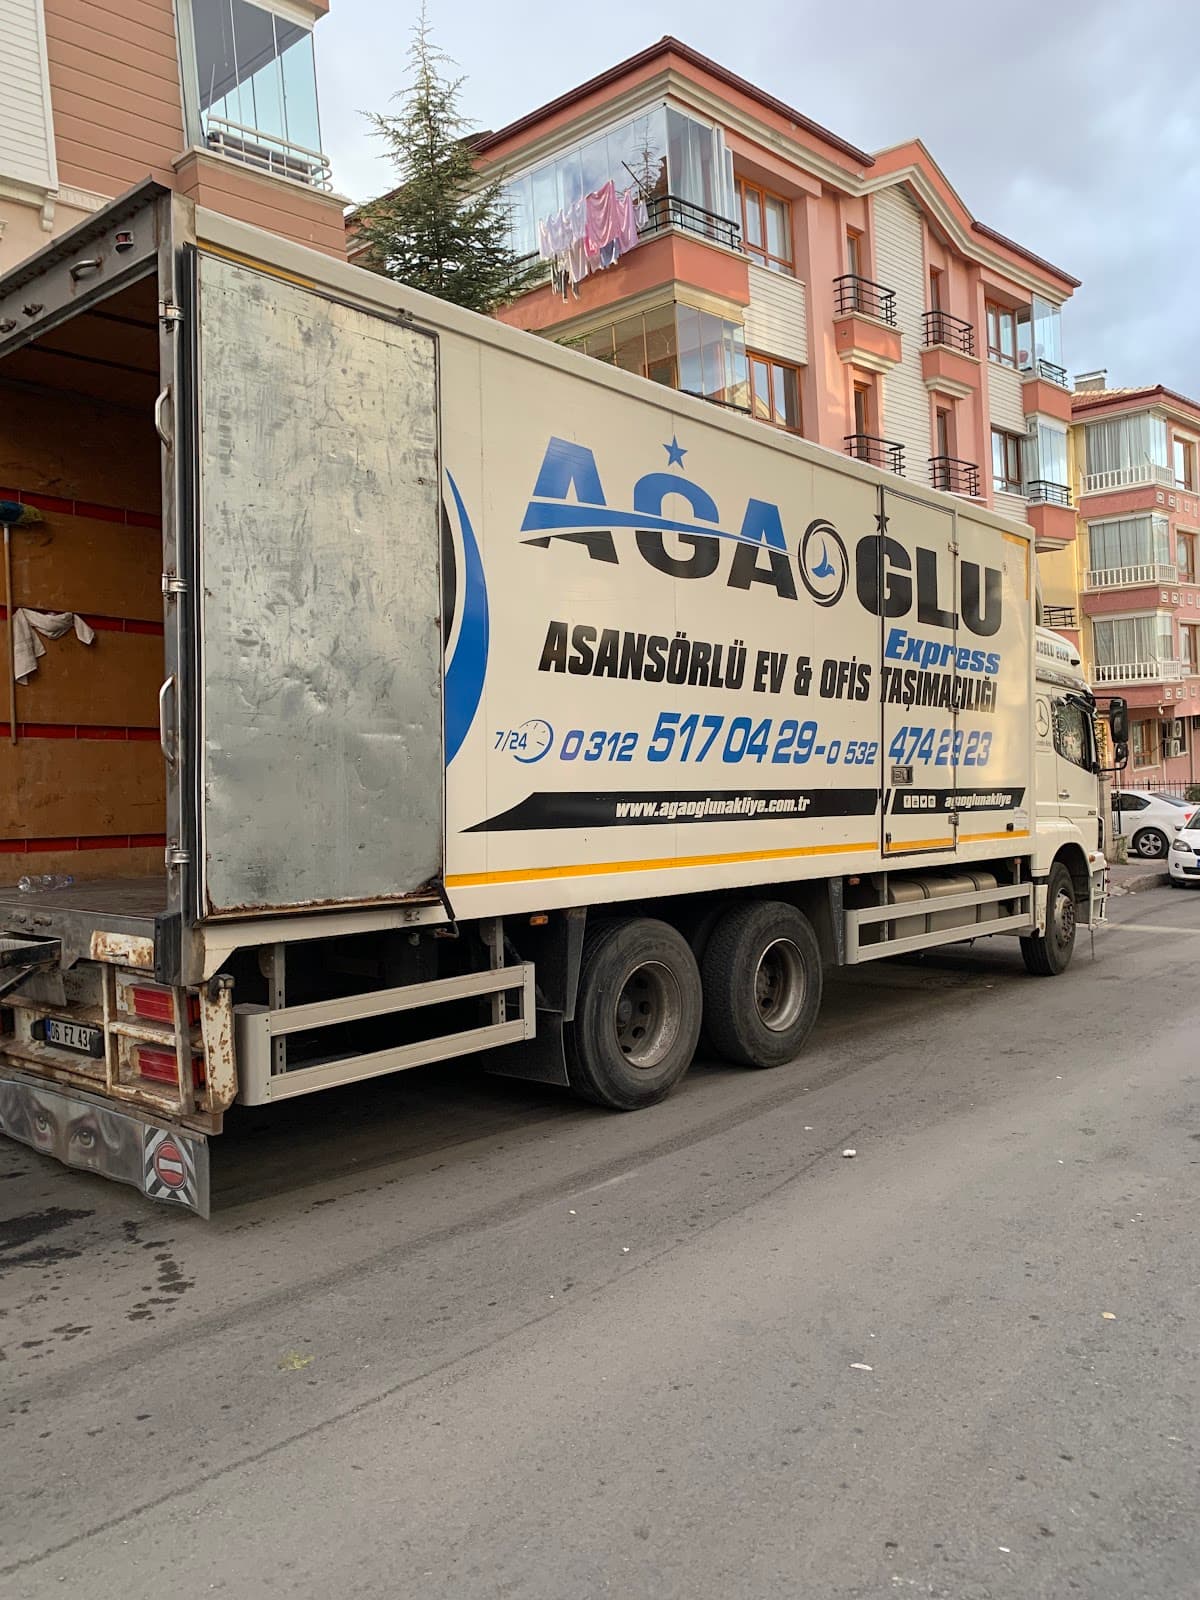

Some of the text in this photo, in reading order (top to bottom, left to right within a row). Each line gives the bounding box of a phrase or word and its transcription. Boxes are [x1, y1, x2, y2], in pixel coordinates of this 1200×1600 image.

[885, 628, 1001, 675] Express
[538, 620, 998, 714] ASANSÖRLÜ EV & OFİS TAŞIMACILIĞI
[494, 730, 527, 752] 7/24
[615, 796, 811, 819] www.agaoglunakliye.com.tr
[64, 1026, 75, 1045] FZ
[78, 1029, 93, 1048] 43
